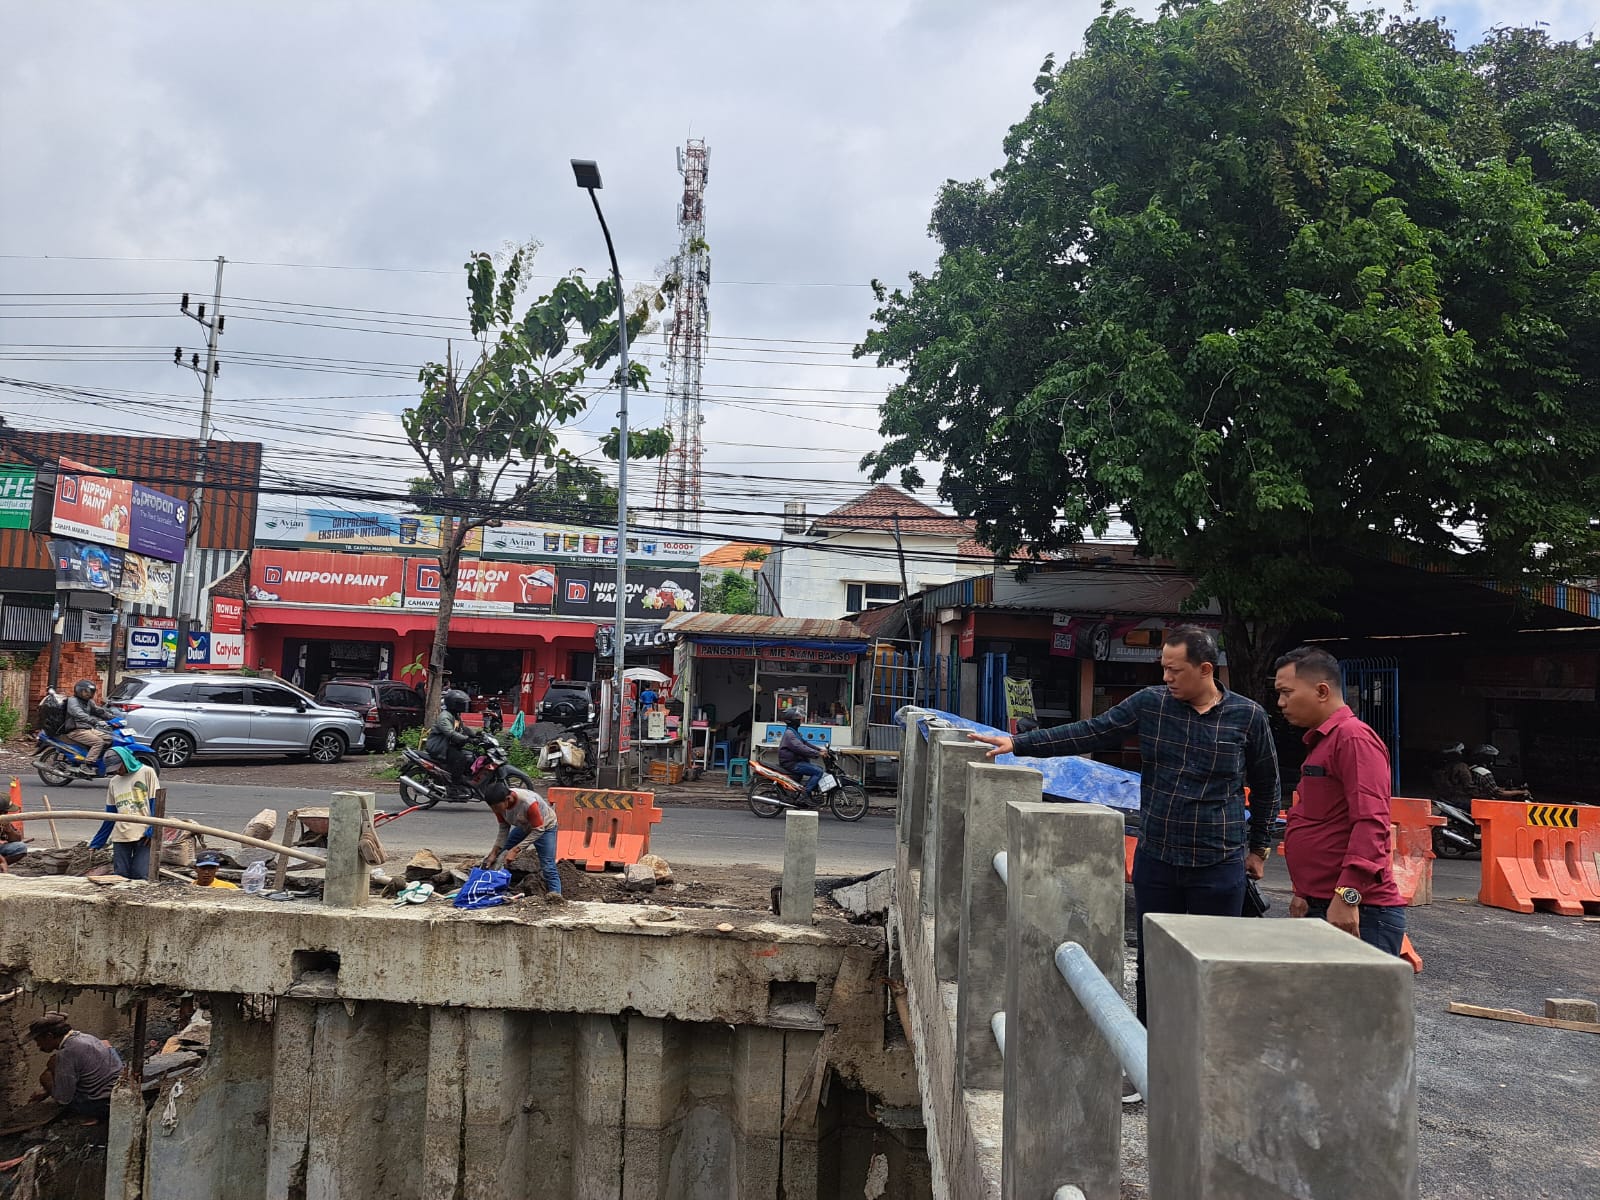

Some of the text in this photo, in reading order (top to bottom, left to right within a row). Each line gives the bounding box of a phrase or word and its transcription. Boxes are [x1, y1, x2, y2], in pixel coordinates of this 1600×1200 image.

[81, 480, 112, 499] NIPPON
[82, 493, 107, 510] PAINT
[140, 491, 174, 515] propan
[280, 519, 304, 528] Avian
[318, 528, 355, 540] EKSTERIOR
[360, 526, 391, 538] INTERIOR
[510, 537, 536, 547] Avian
[284, 570, 388, 587] NIPPON PAINT
[592, 582, 644, 593] NIPON
[187, 647, 207, 660] Dulux
[215, 640, 242, 661] Catylac
[701, 645, 740, 657] PANGSIT
[769, 647, 787, 658] MIE
[789, 648, 816, 660] AYAM
[817, 650, 851, 662] BAKSO
